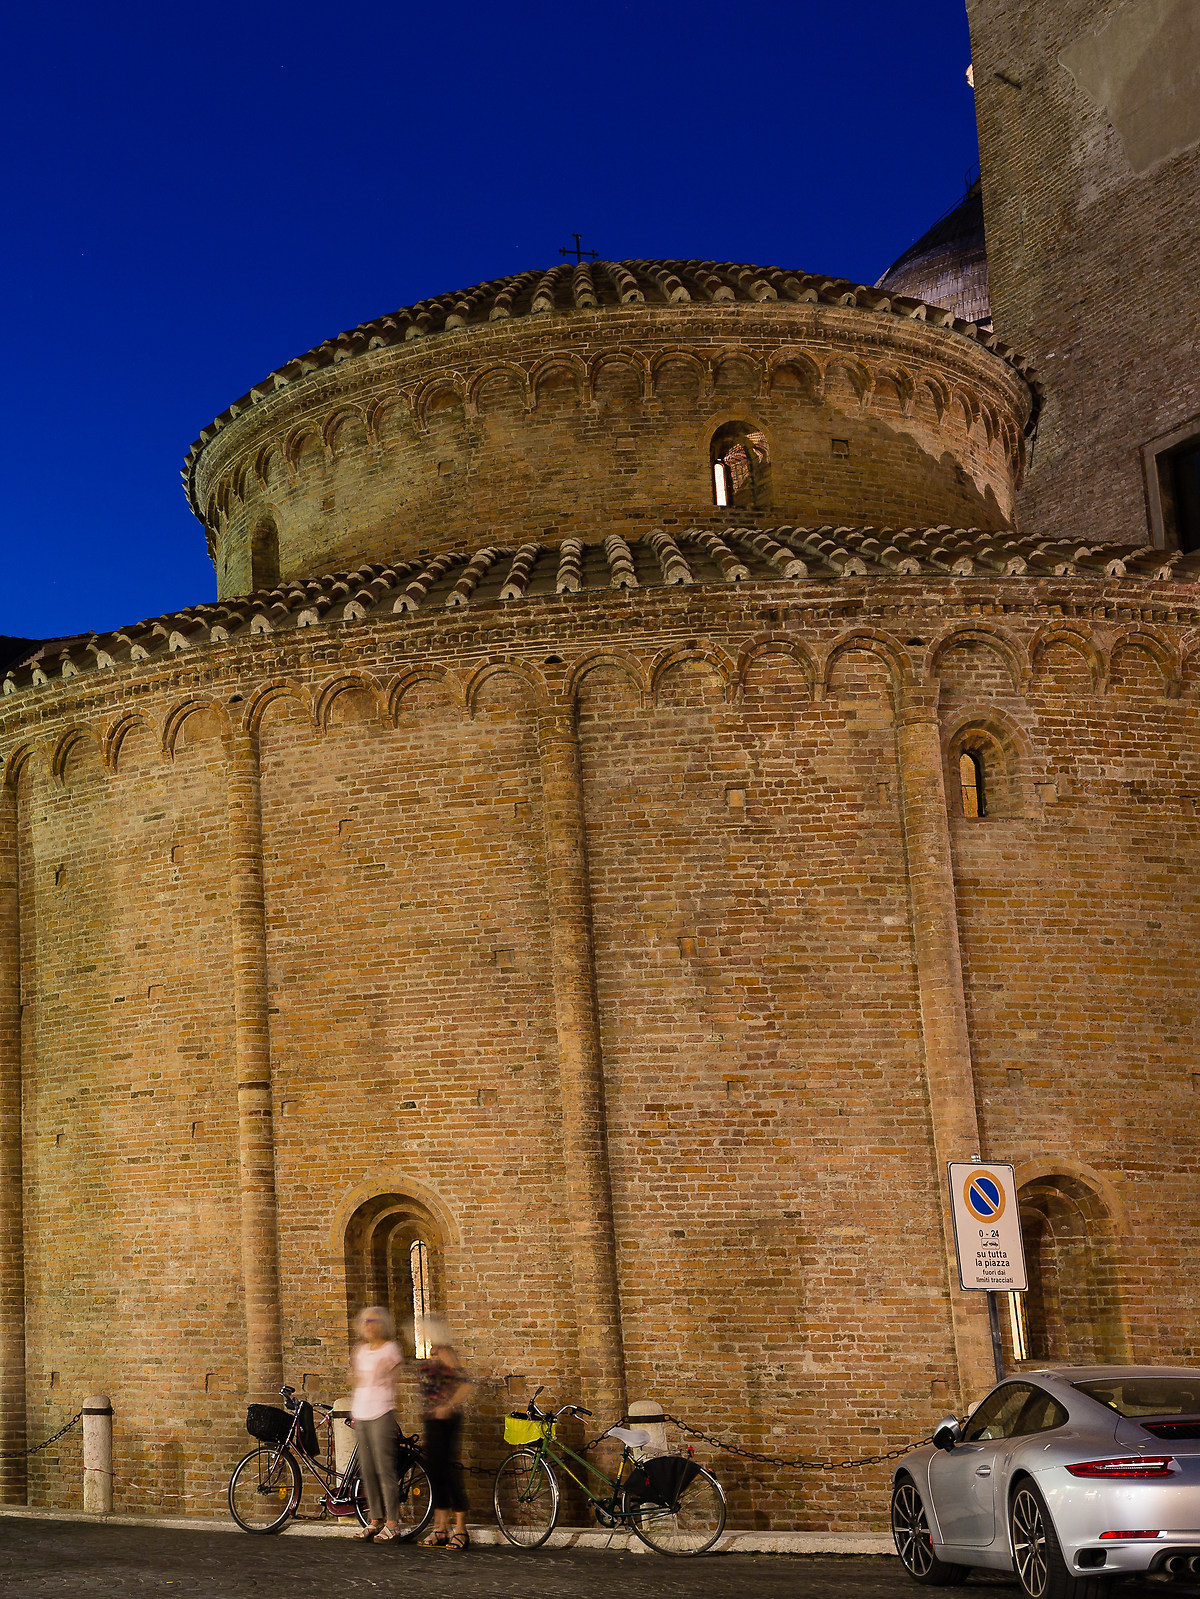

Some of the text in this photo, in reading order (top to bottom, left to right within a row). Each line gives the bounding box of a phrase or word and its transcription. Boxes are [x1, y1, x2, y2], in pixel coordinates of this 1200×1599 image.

[979, 1229, 984, 1237] 0
[991, 1229, 1000, 1237] 24
[975, 1258, 1010, 1268] la piazza
